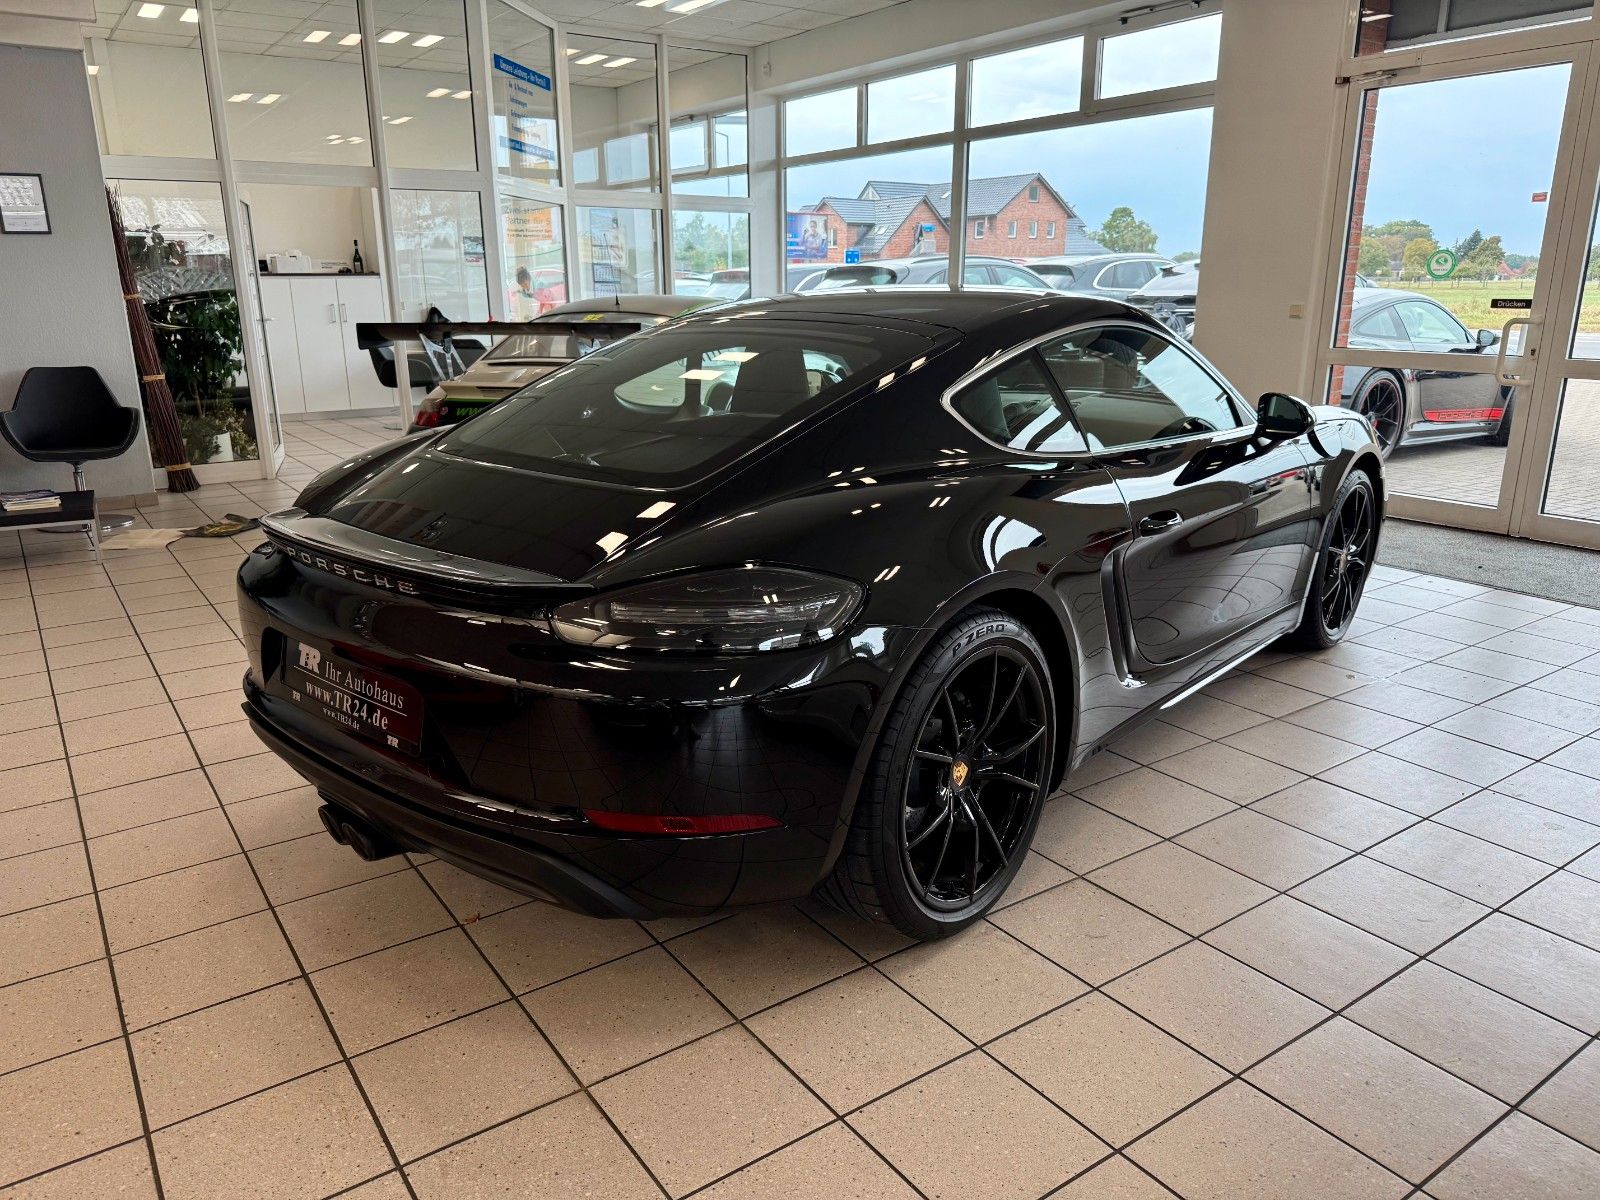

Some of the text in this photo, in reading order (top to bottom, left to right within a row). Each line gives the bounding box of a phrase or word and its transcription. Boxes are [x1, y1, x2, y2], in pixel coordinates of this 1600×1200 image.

[1497, 300, 1526, 308] Drücken
[286, 546, 420, 595] PORSCHE
[952, 623, 1006, 659] P ZERO
[305, 681, 389, 730] www.TR24.de
[325, 660, 404, 709] Ihr Autohaus
[322, 707, 361, 731] www.TR24.de
